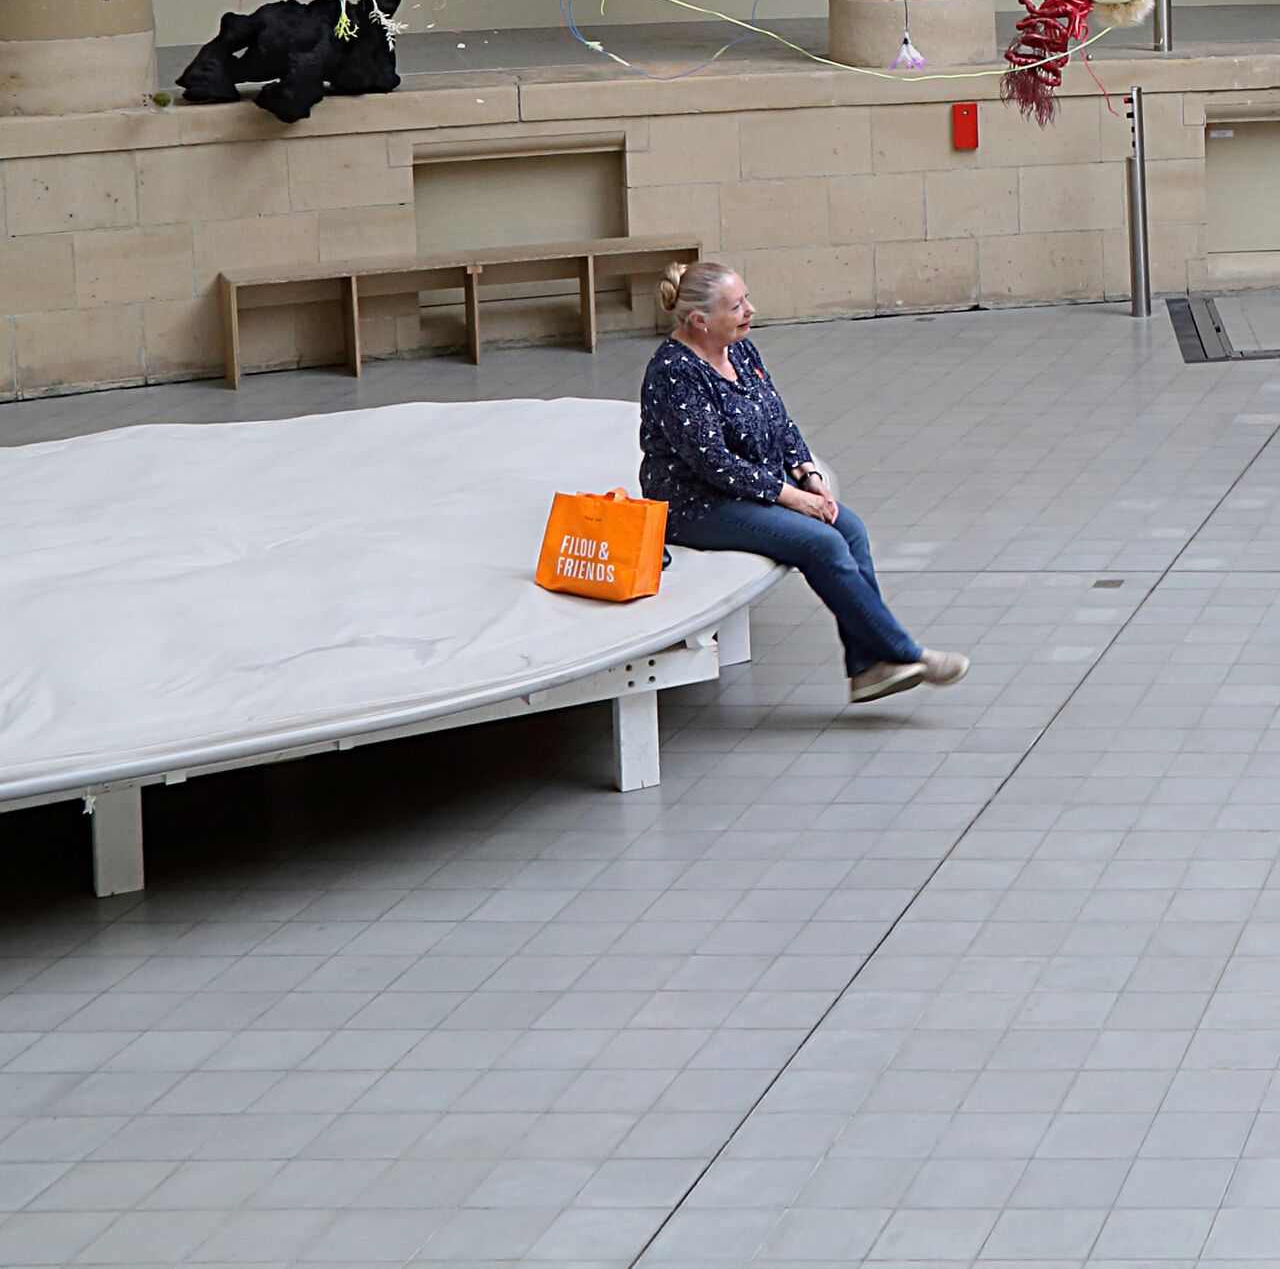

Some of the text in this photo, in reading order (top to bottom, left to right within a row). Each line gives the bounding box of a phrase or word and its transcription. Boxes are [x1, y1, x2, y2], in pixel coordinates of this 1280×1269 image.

[560, 535, 610, 561] FILOU &
[556, 556, 615, 583] FRIENDS
